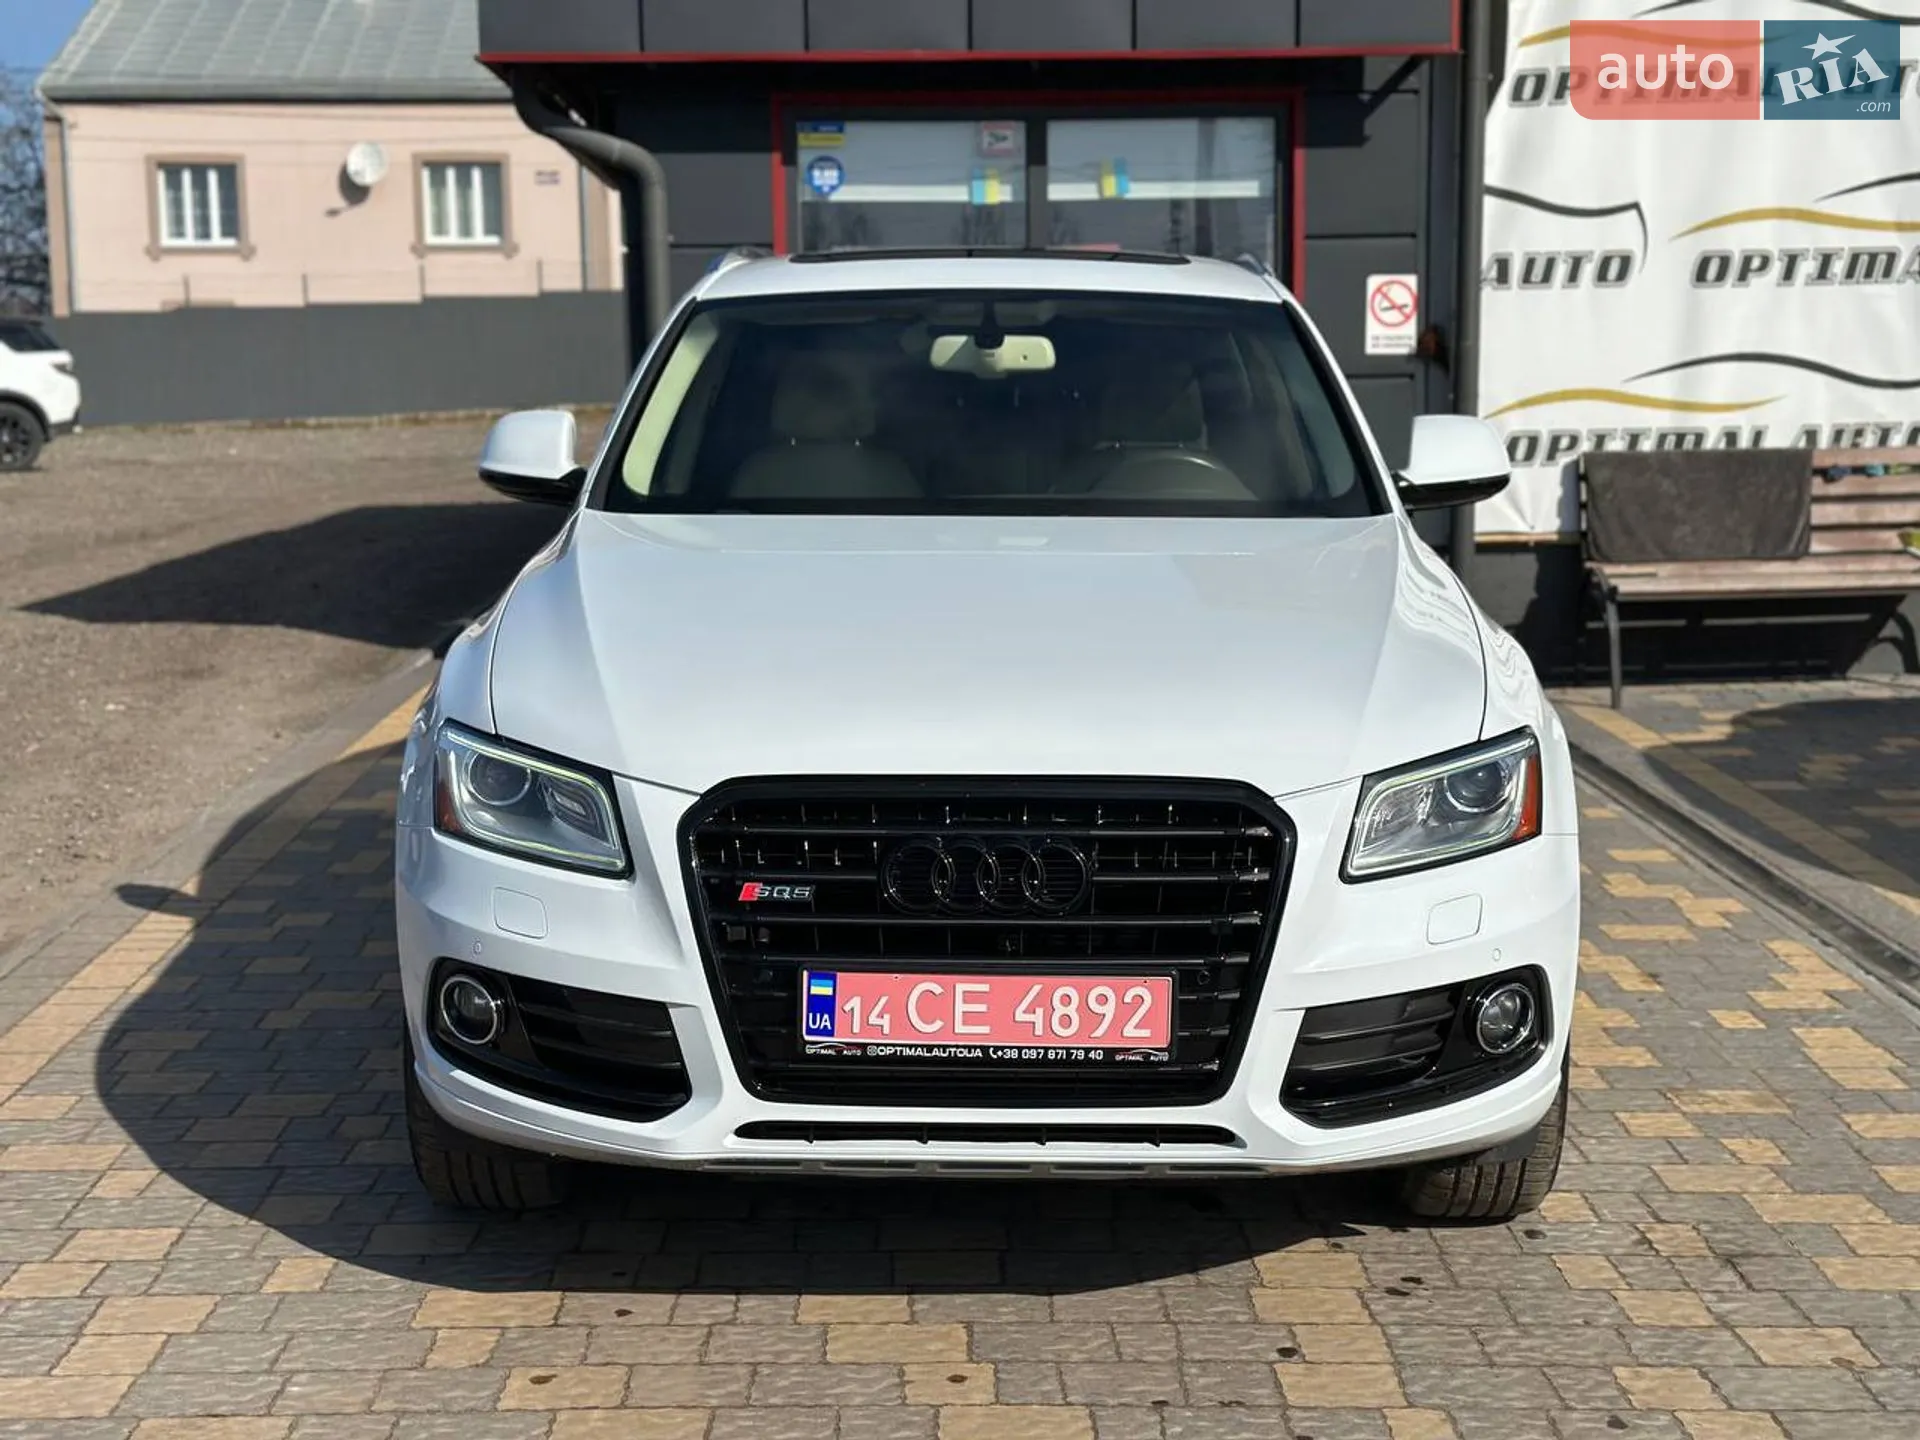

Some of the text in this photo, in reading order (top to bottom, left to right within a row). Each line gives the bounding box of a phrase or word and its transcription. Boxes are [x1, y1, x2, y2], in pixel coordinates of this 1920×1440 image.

[1480, 249, 1636, 291] AUTO
[808, 1012, 832, 1030] UA
[841, 982, 1153, 1039] 14 CE 4892
[997, 1048, 1018, 1059] +38
[1022, 1048, 1044, 1060] 097
[1070, 1049, 1085, 1060] 79
[1088, 1049, 1104, 1060] 40
